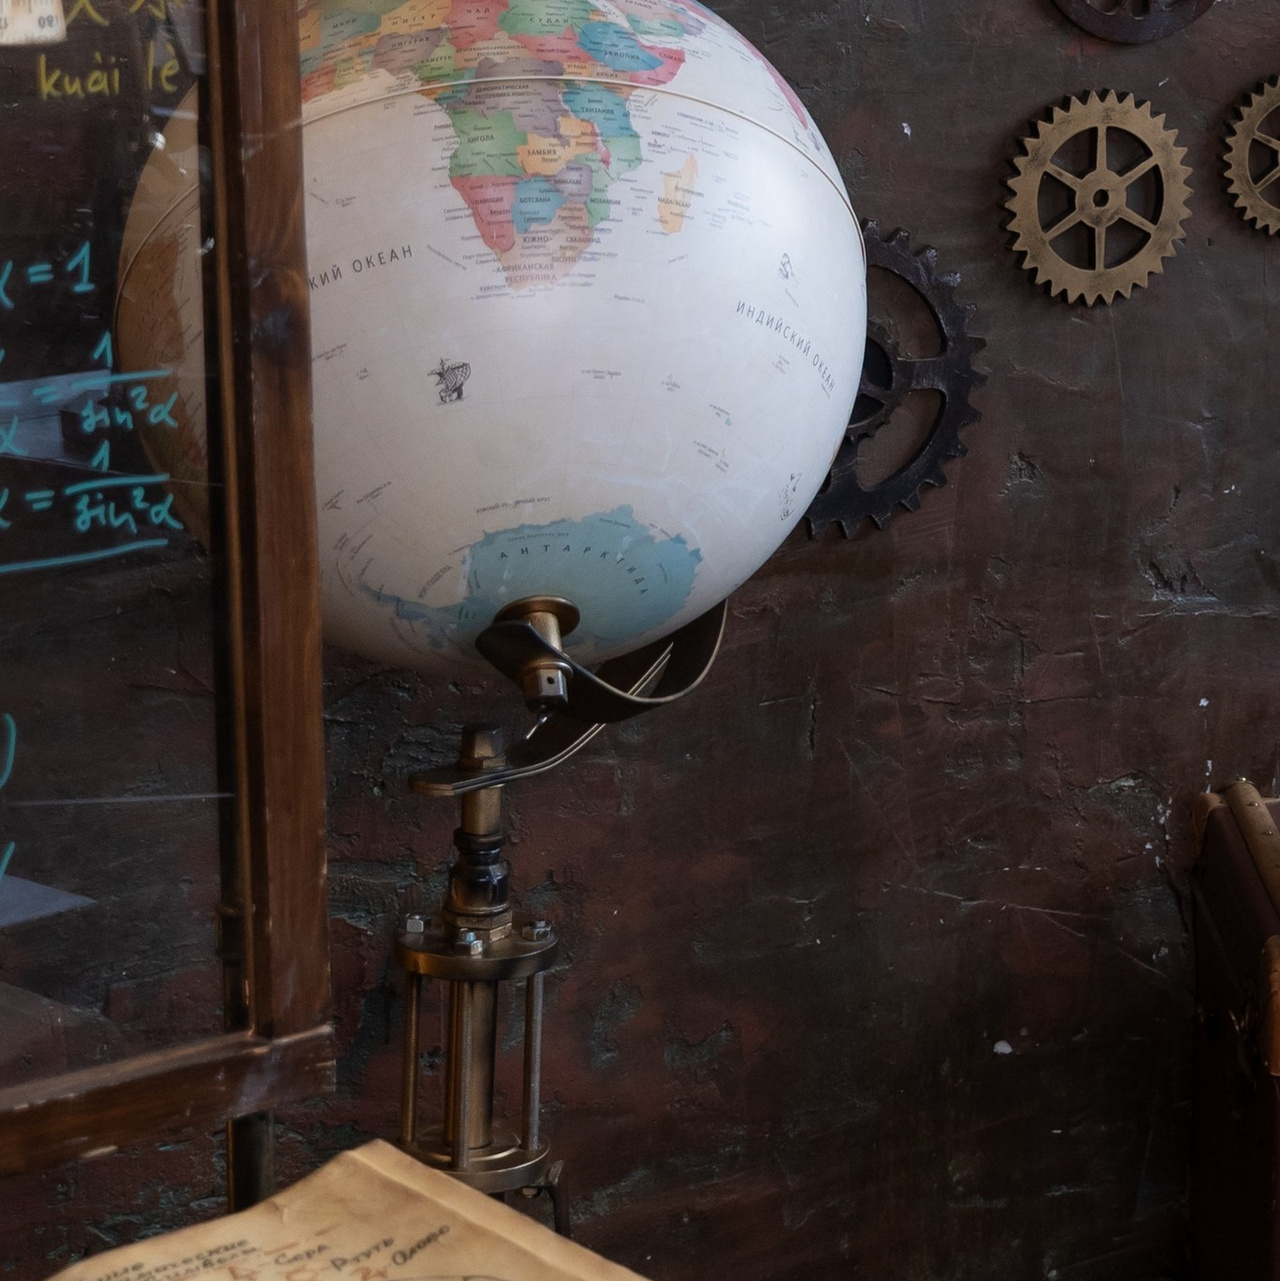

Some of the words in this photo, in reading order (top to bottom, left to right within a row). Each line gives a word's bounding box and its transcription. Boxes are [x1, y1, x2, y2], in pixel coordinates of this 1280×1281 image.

[580, 106, 615, 115] ТАНЗАНИЯ
[466, 134, 496, 145] АНГОЛА
[527, 148, 558, 157] ЗАМБИЯ
[519, 196, 552, 204] БОТСВАНА
[657, 196, 692, 209] МАДАГАСКАР
[522, 235, 554, 244] ЮЖНО-
[352, 244, 414, 273] ОКЕАН
[504, 274, 558, 284] РЕСПУБЛИКА
[735, 300, 812, 358] ИНДИЙСКИЙ
[811, 353, 836, 392] ОКЕАН
[499, 544, 650, 596] АНТАРКТИДА
